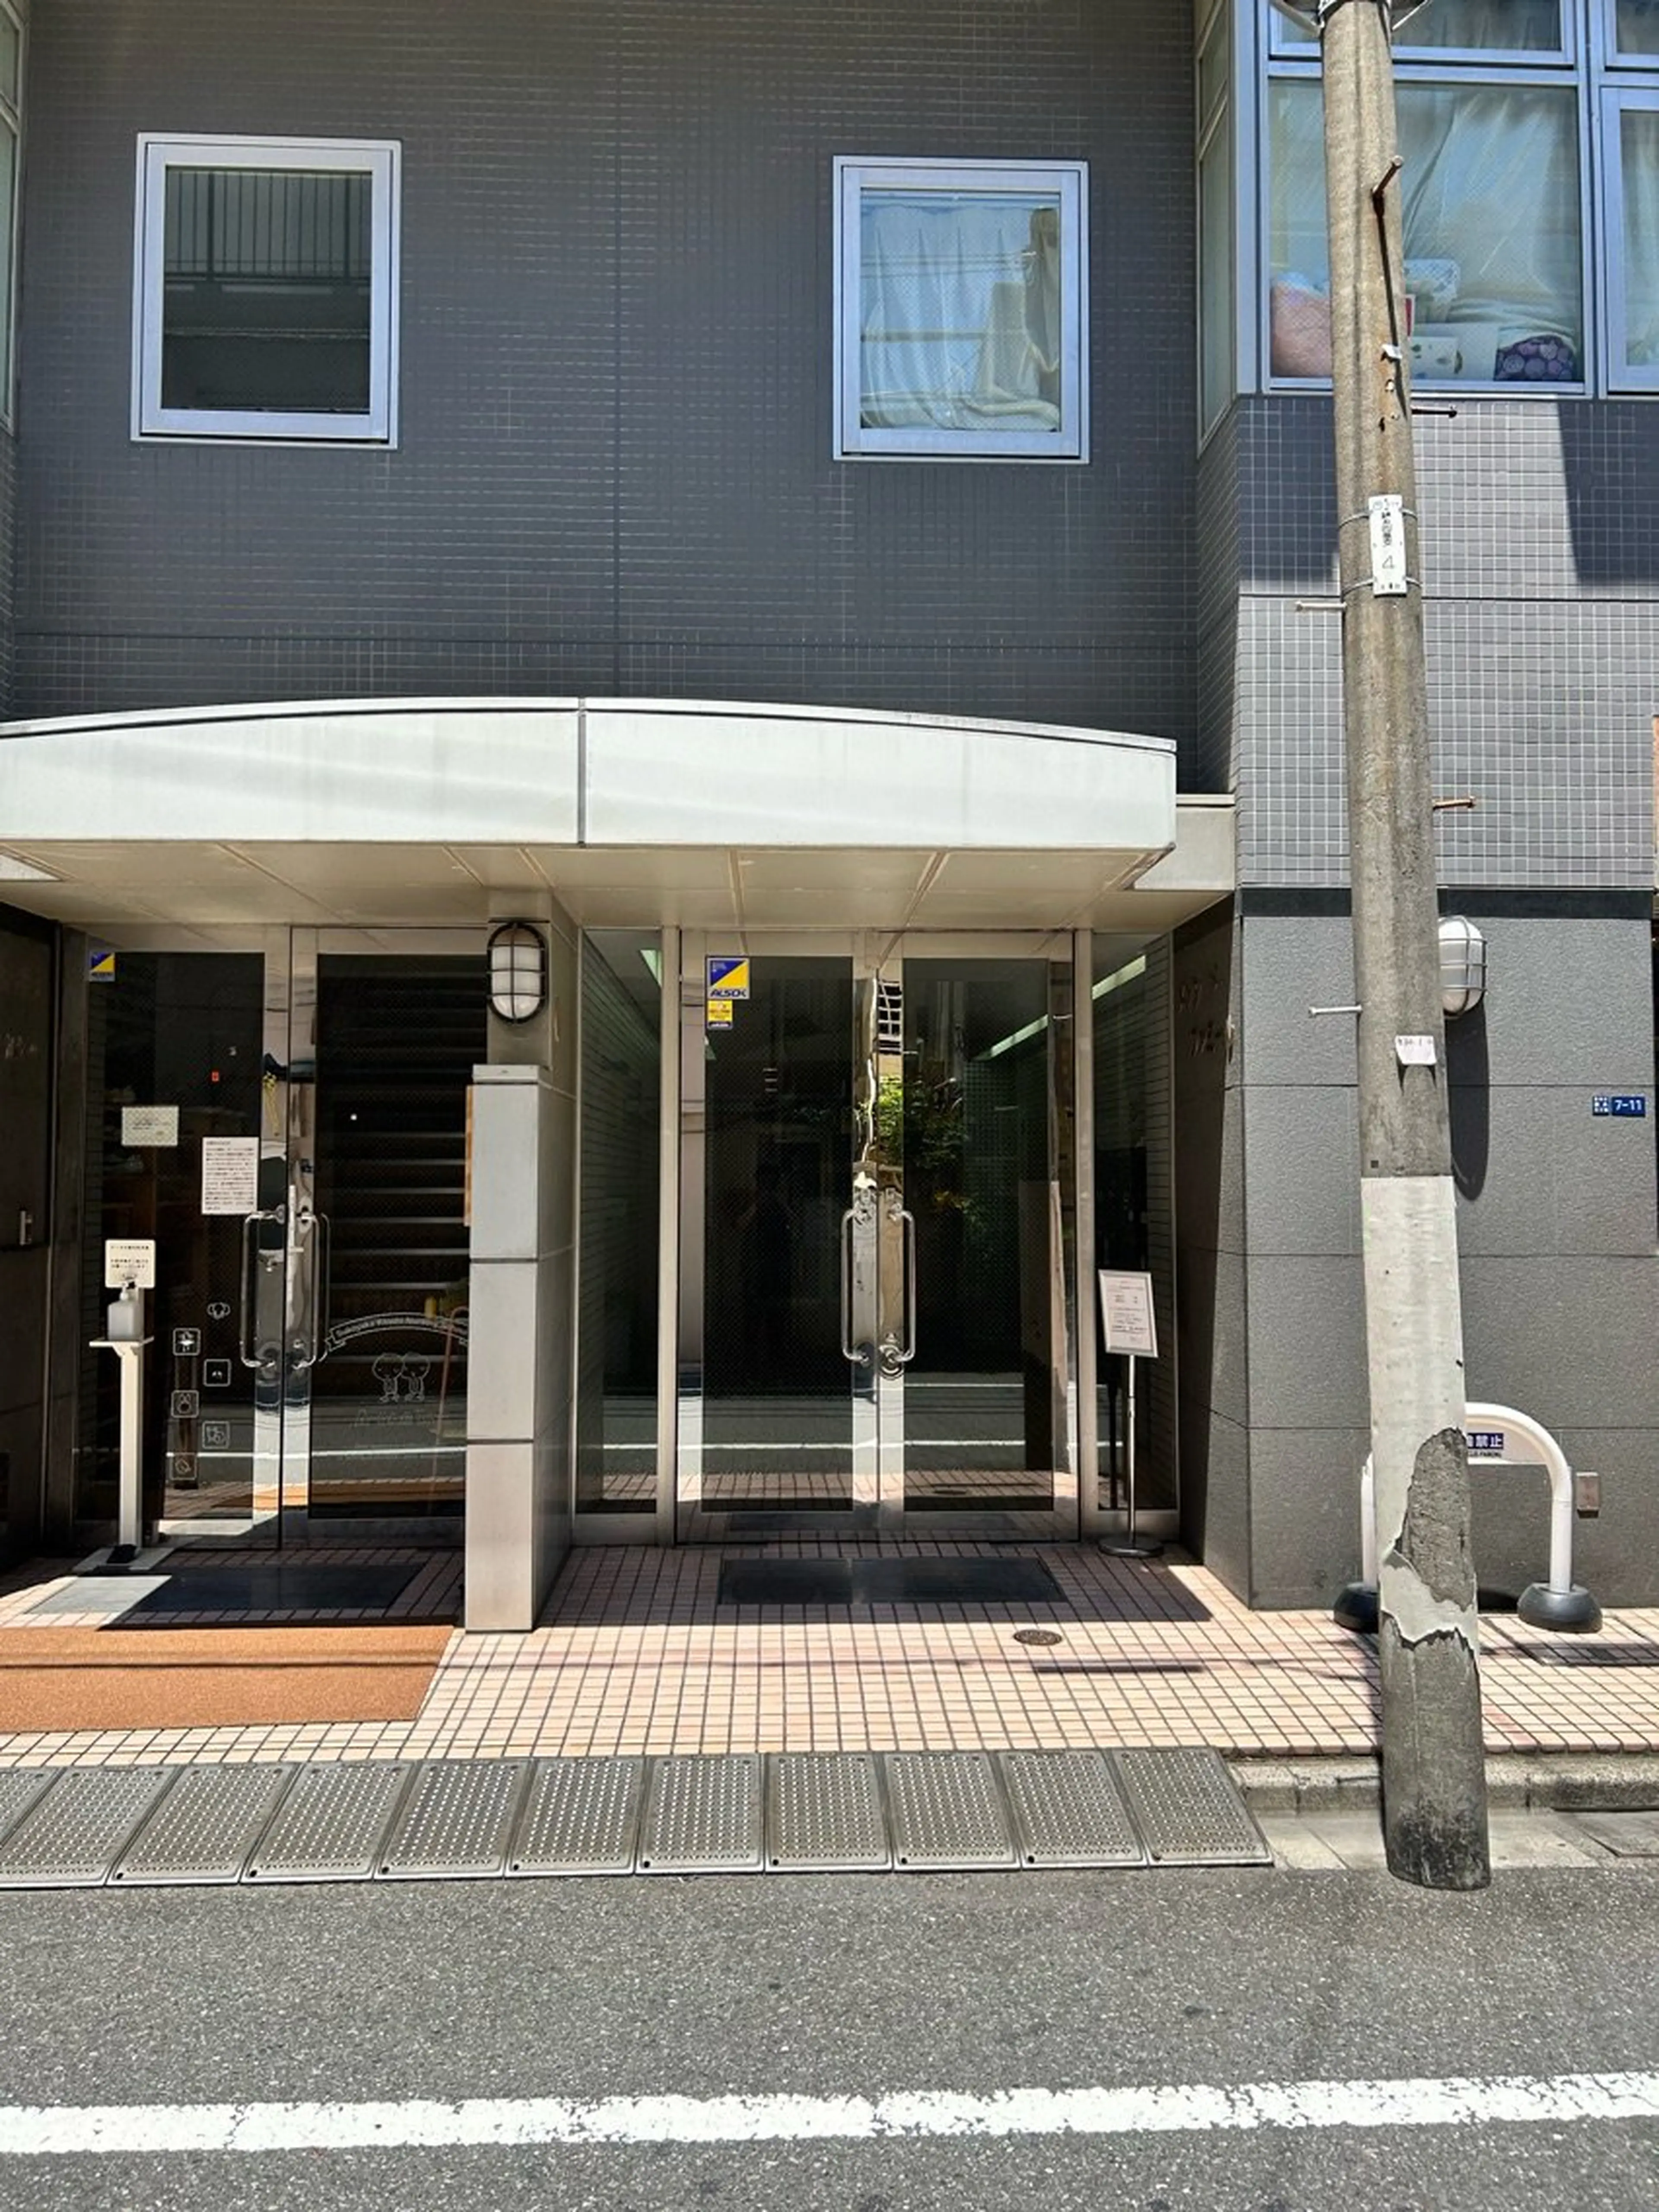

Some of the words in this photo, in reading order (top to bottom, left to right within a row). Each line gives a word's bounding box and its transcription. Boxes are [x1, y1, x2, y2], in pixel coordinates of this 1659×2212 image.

[1382, 554, 1395, 569] 4
[710, 989, 747, 998] ALSOK
[1614, 1099, 1642, 1111] 7-11
